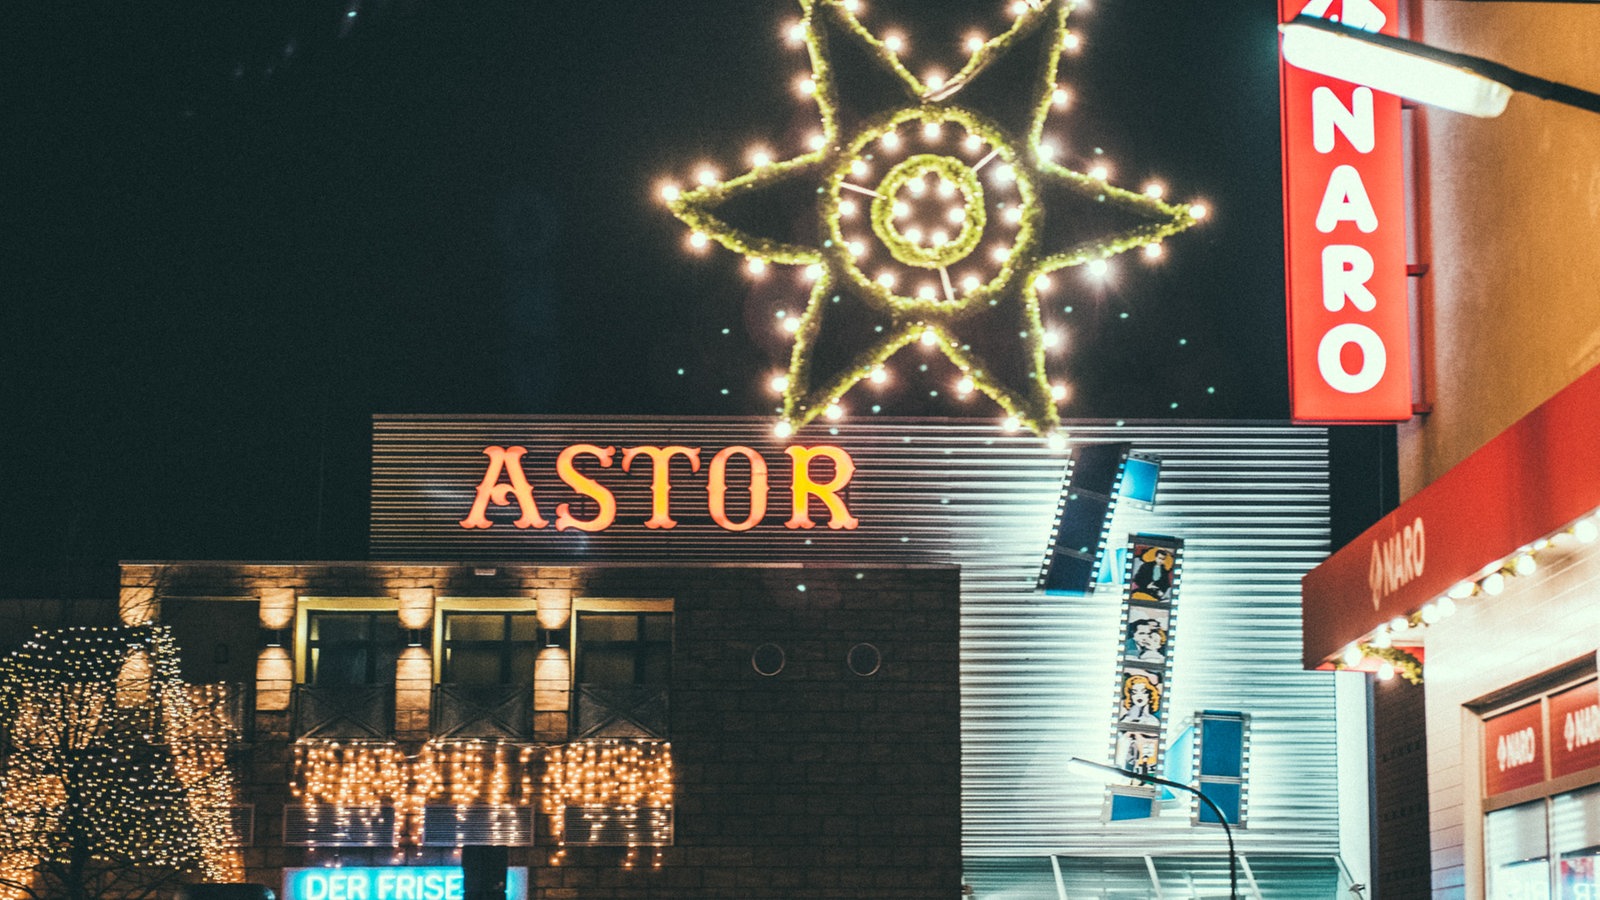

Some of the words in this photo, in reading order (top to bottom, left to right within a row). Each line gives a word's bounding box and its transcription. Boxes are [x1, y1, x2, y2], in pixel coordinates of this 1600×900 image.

[1312, 86, 1387, 394] NARO
[459, 444, 859, 531] ASTOR
[1383, 516, 1425, 597] NARO
[1506, 726, 1535, 769] NARO
[305, 875, 369, 900] DER
[378, 875, 465, 900] FRISE
